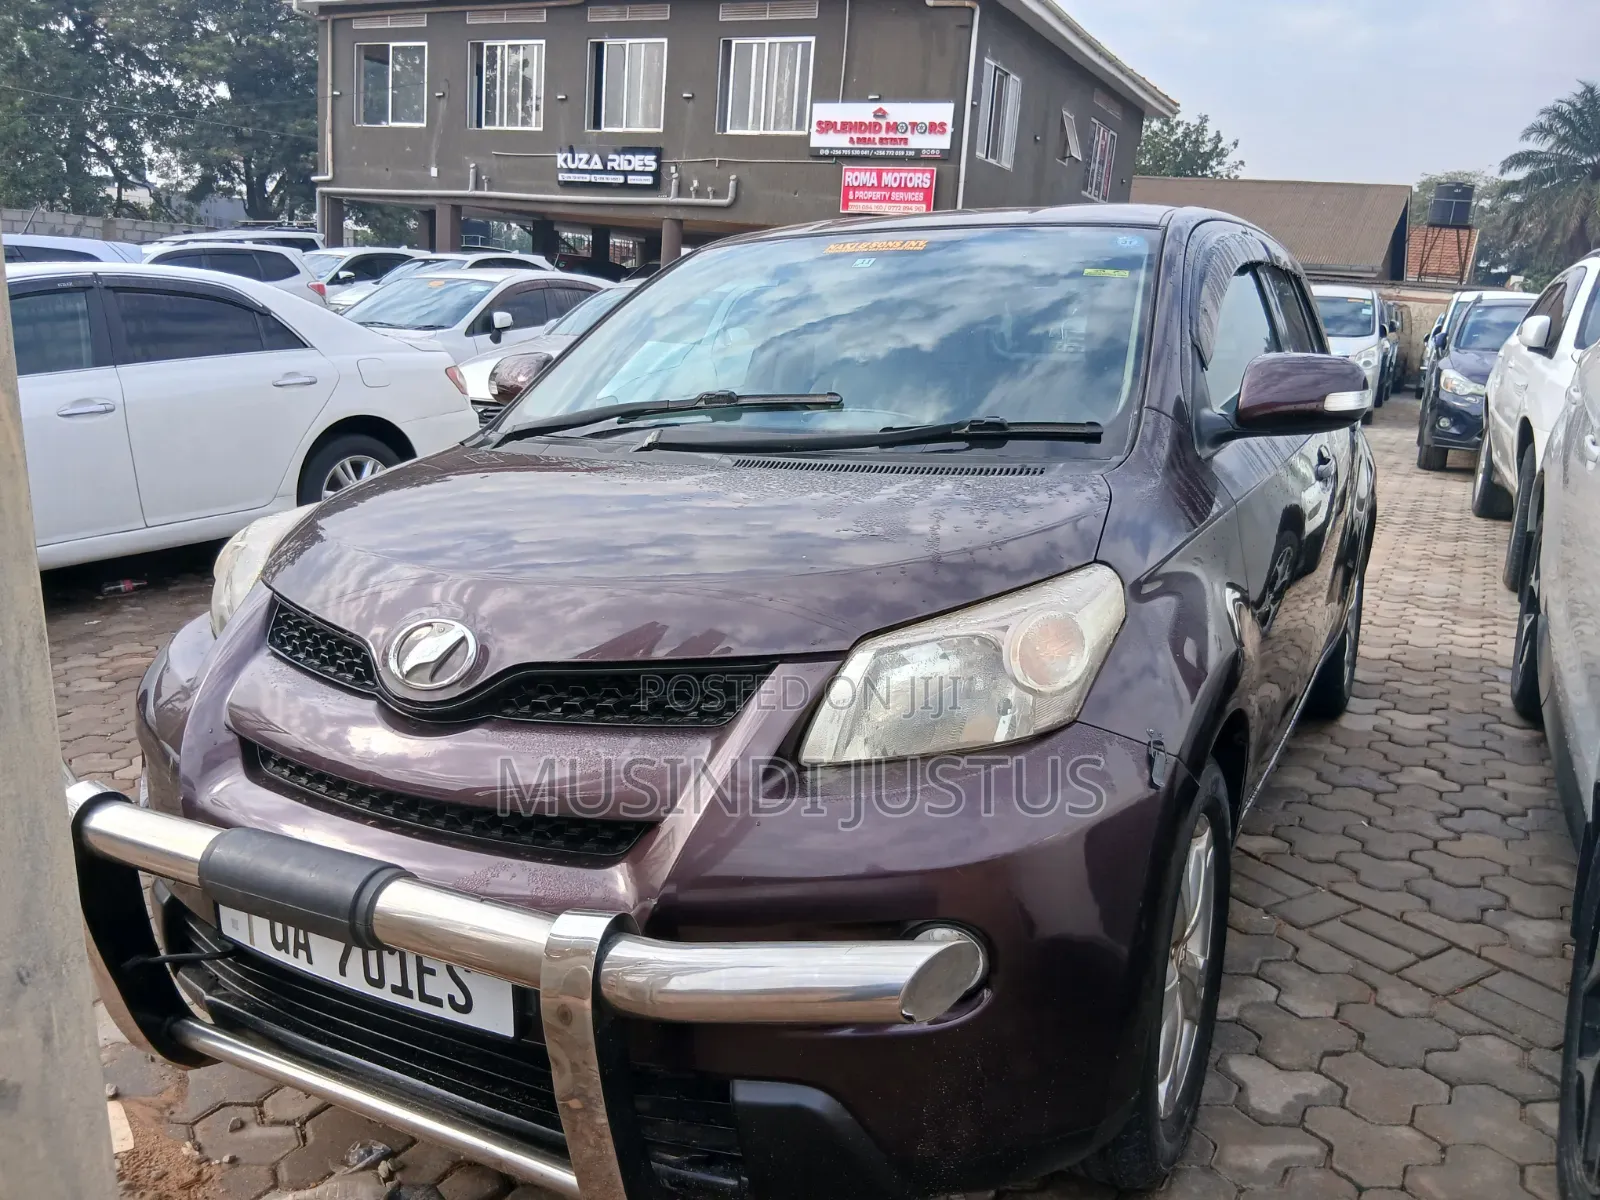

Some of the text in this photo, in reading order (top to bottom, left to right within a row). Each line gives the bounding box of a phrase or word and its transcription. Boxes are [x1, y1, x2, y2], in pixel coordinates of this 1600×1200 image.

[816, 120, 947, 135] SPLENDID MOTORS
[856, 137, 877, 145] REAL
[878, 137, 908, 146] ESTATE
[556, 153, 657, 171] KUZA RIDES
[845, 171, 931, 188] ROMA MOTORS
[848, 191, 924, 201] & PROPERTY SERVICES
